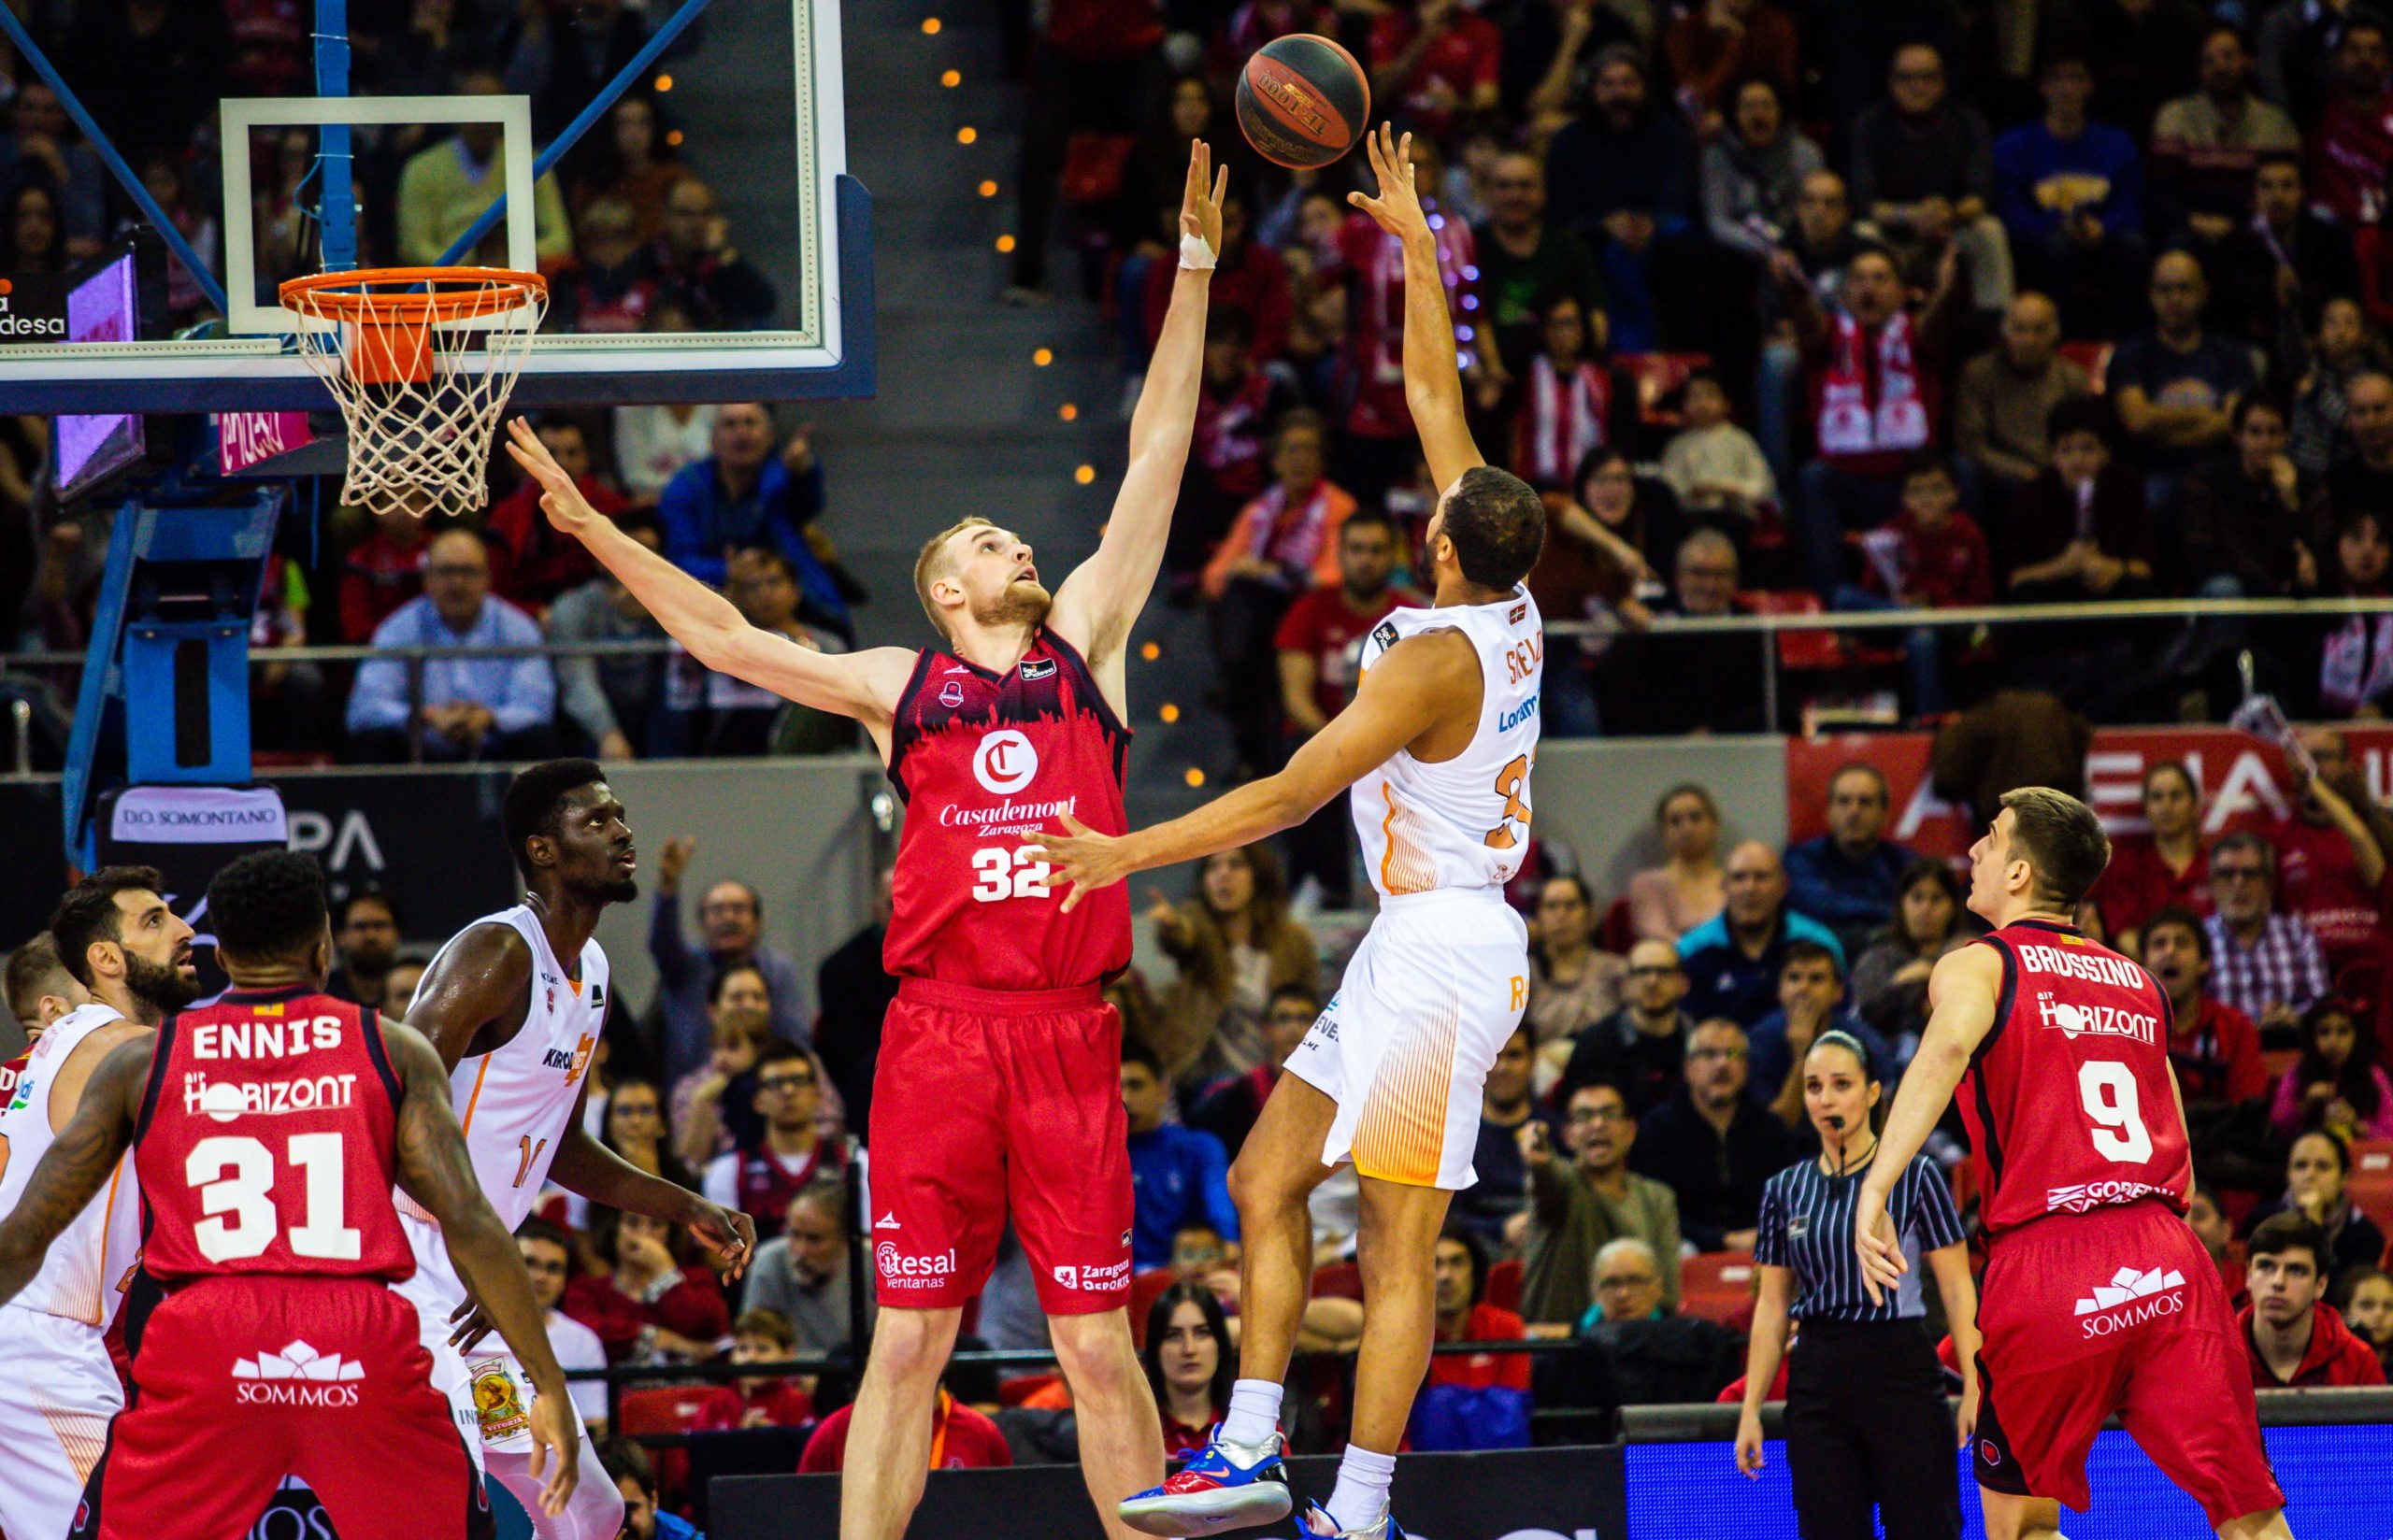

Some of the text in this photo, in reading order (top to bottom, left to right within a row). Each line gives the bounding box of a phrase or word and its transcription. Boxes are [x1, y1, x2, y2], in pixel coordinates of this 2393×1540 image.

[0, 314, 65, 335] desa
[159, 808, 277, 825] SOMONTANO
[972, 845, 1051, 903] 32
[2017, 945, 2143, 990] BRUSSINO
[193, 1016, 341, 1059] ENNIS
[2078, 1060, 2154, 1164] 9
[185, 1132, 361, 1264] 31
[887, 1276, 945, 1289] ventanas
[2082, 1290, 2184, 1339] SOMMOS
[236, 1382, 359, 1407] SOMMOS
[486, 1417, 524, 1432] VITORIA
